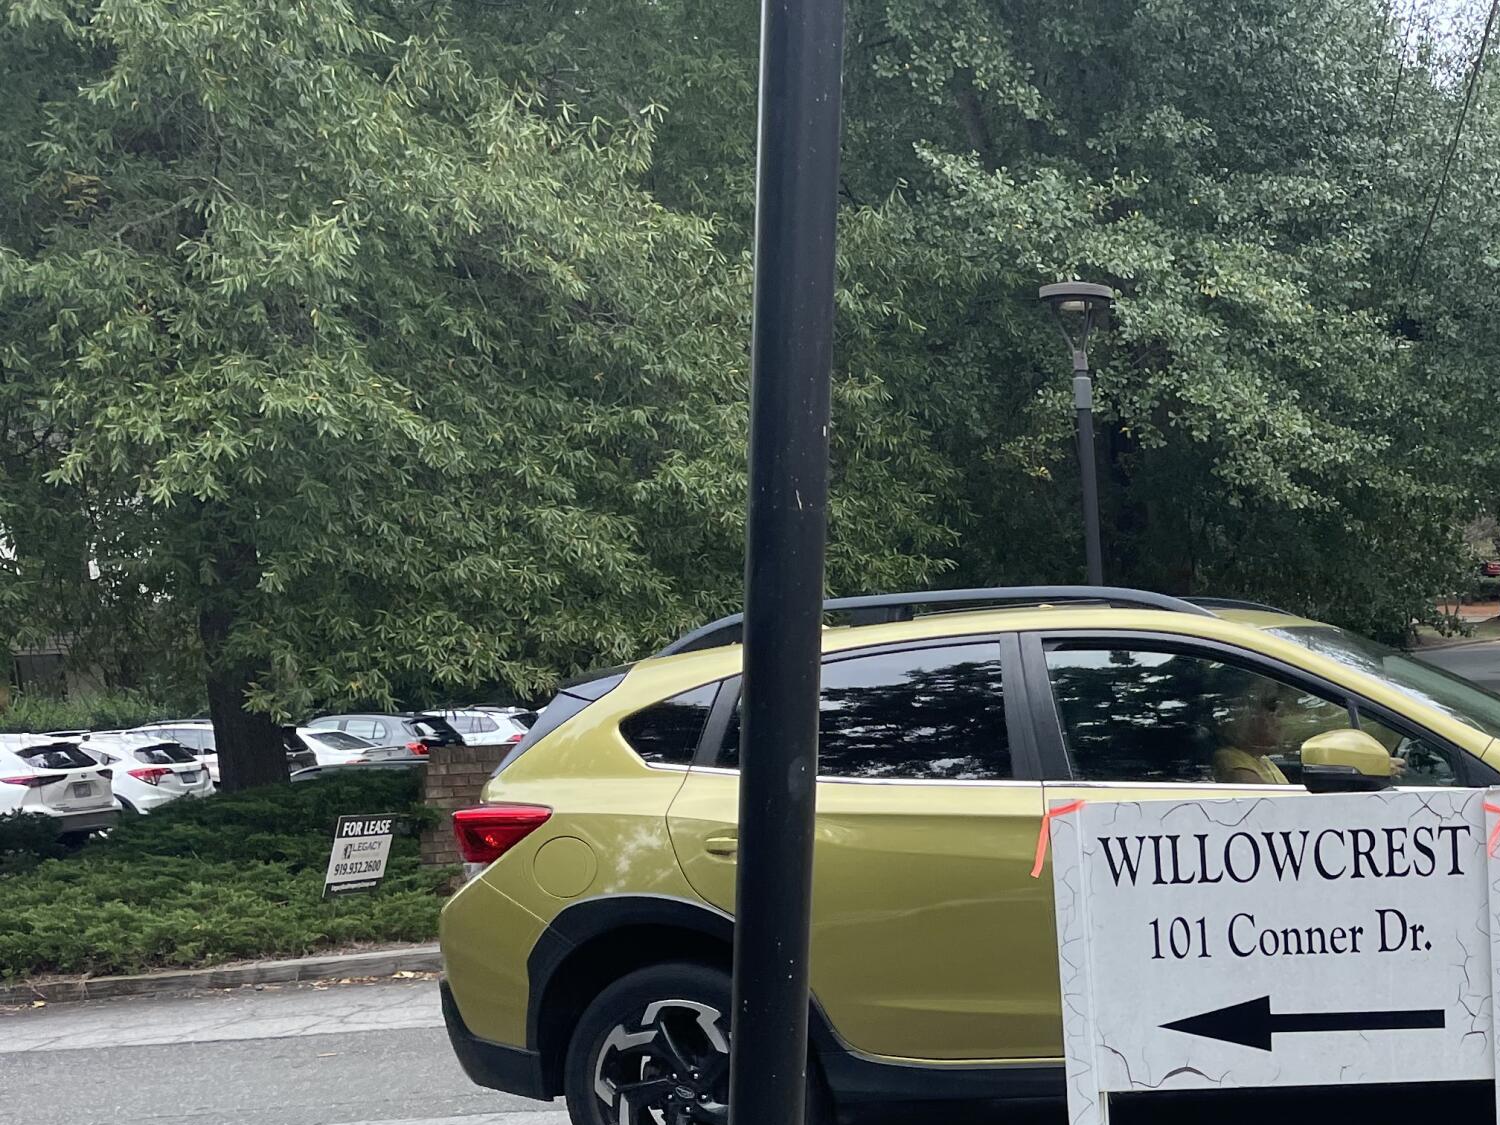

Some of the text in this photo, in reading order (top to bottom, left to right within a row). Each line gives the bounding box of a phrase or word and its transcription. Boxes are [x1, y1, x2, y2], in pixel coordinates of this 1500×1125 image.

[342, 820, 392, 836] FOR LEASE
[352, 841, 383, 852] LEGACY
[1097, 825, 1471, 887] WILLOWCREST
[1148, 909, 1432, 960] 101 Conner Dr.
